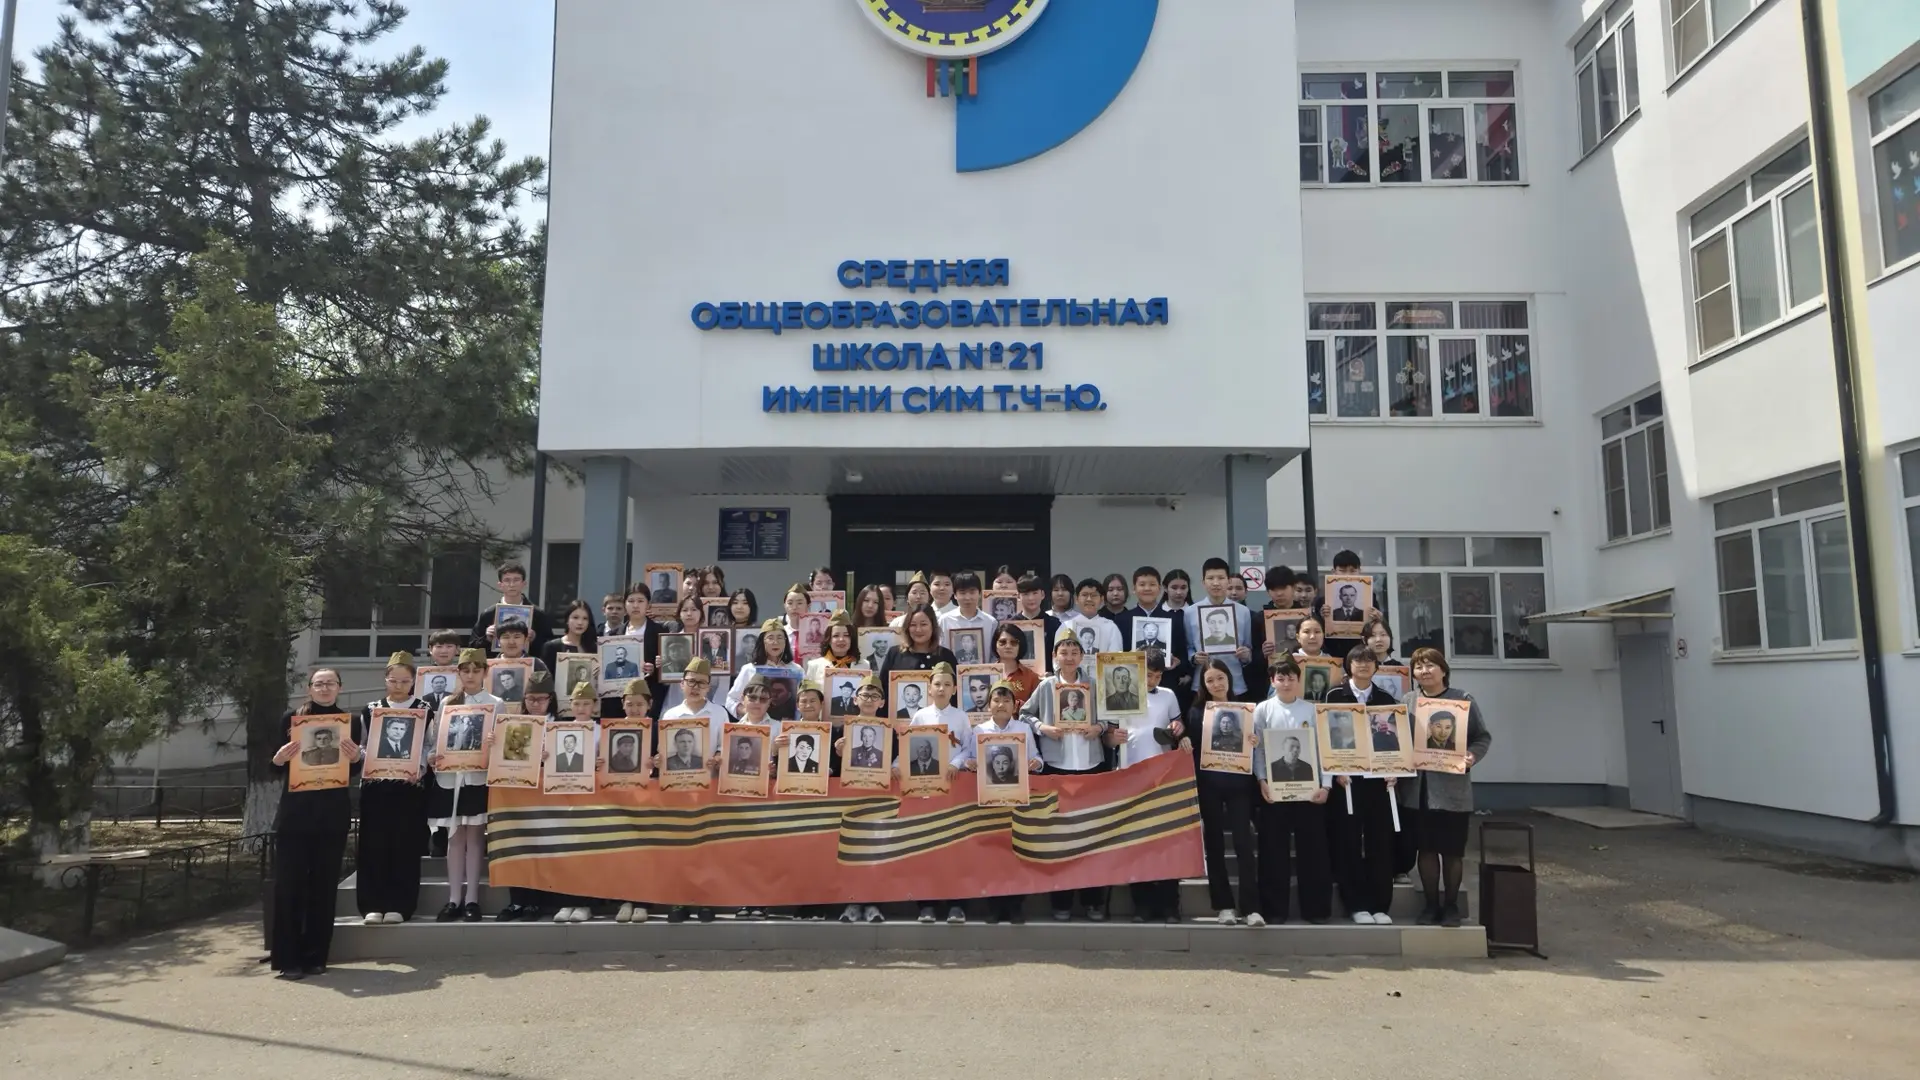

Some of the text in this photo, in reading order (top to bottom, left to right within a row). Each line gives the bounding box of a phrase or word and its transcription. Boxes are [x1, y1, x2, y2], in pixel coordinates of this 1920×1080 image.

[837, 259, 1009, 292] СРЕДНЯЯ
[691, 298, 1168, 333] ОБЩЕОБРАЗОВАТЕЛЬНАЯ
[813, 342, 952, 370] ШКОЛА
[763, 386, 892, 412] ИМЕНИ
[902, 385, 985, 412] СИМ
